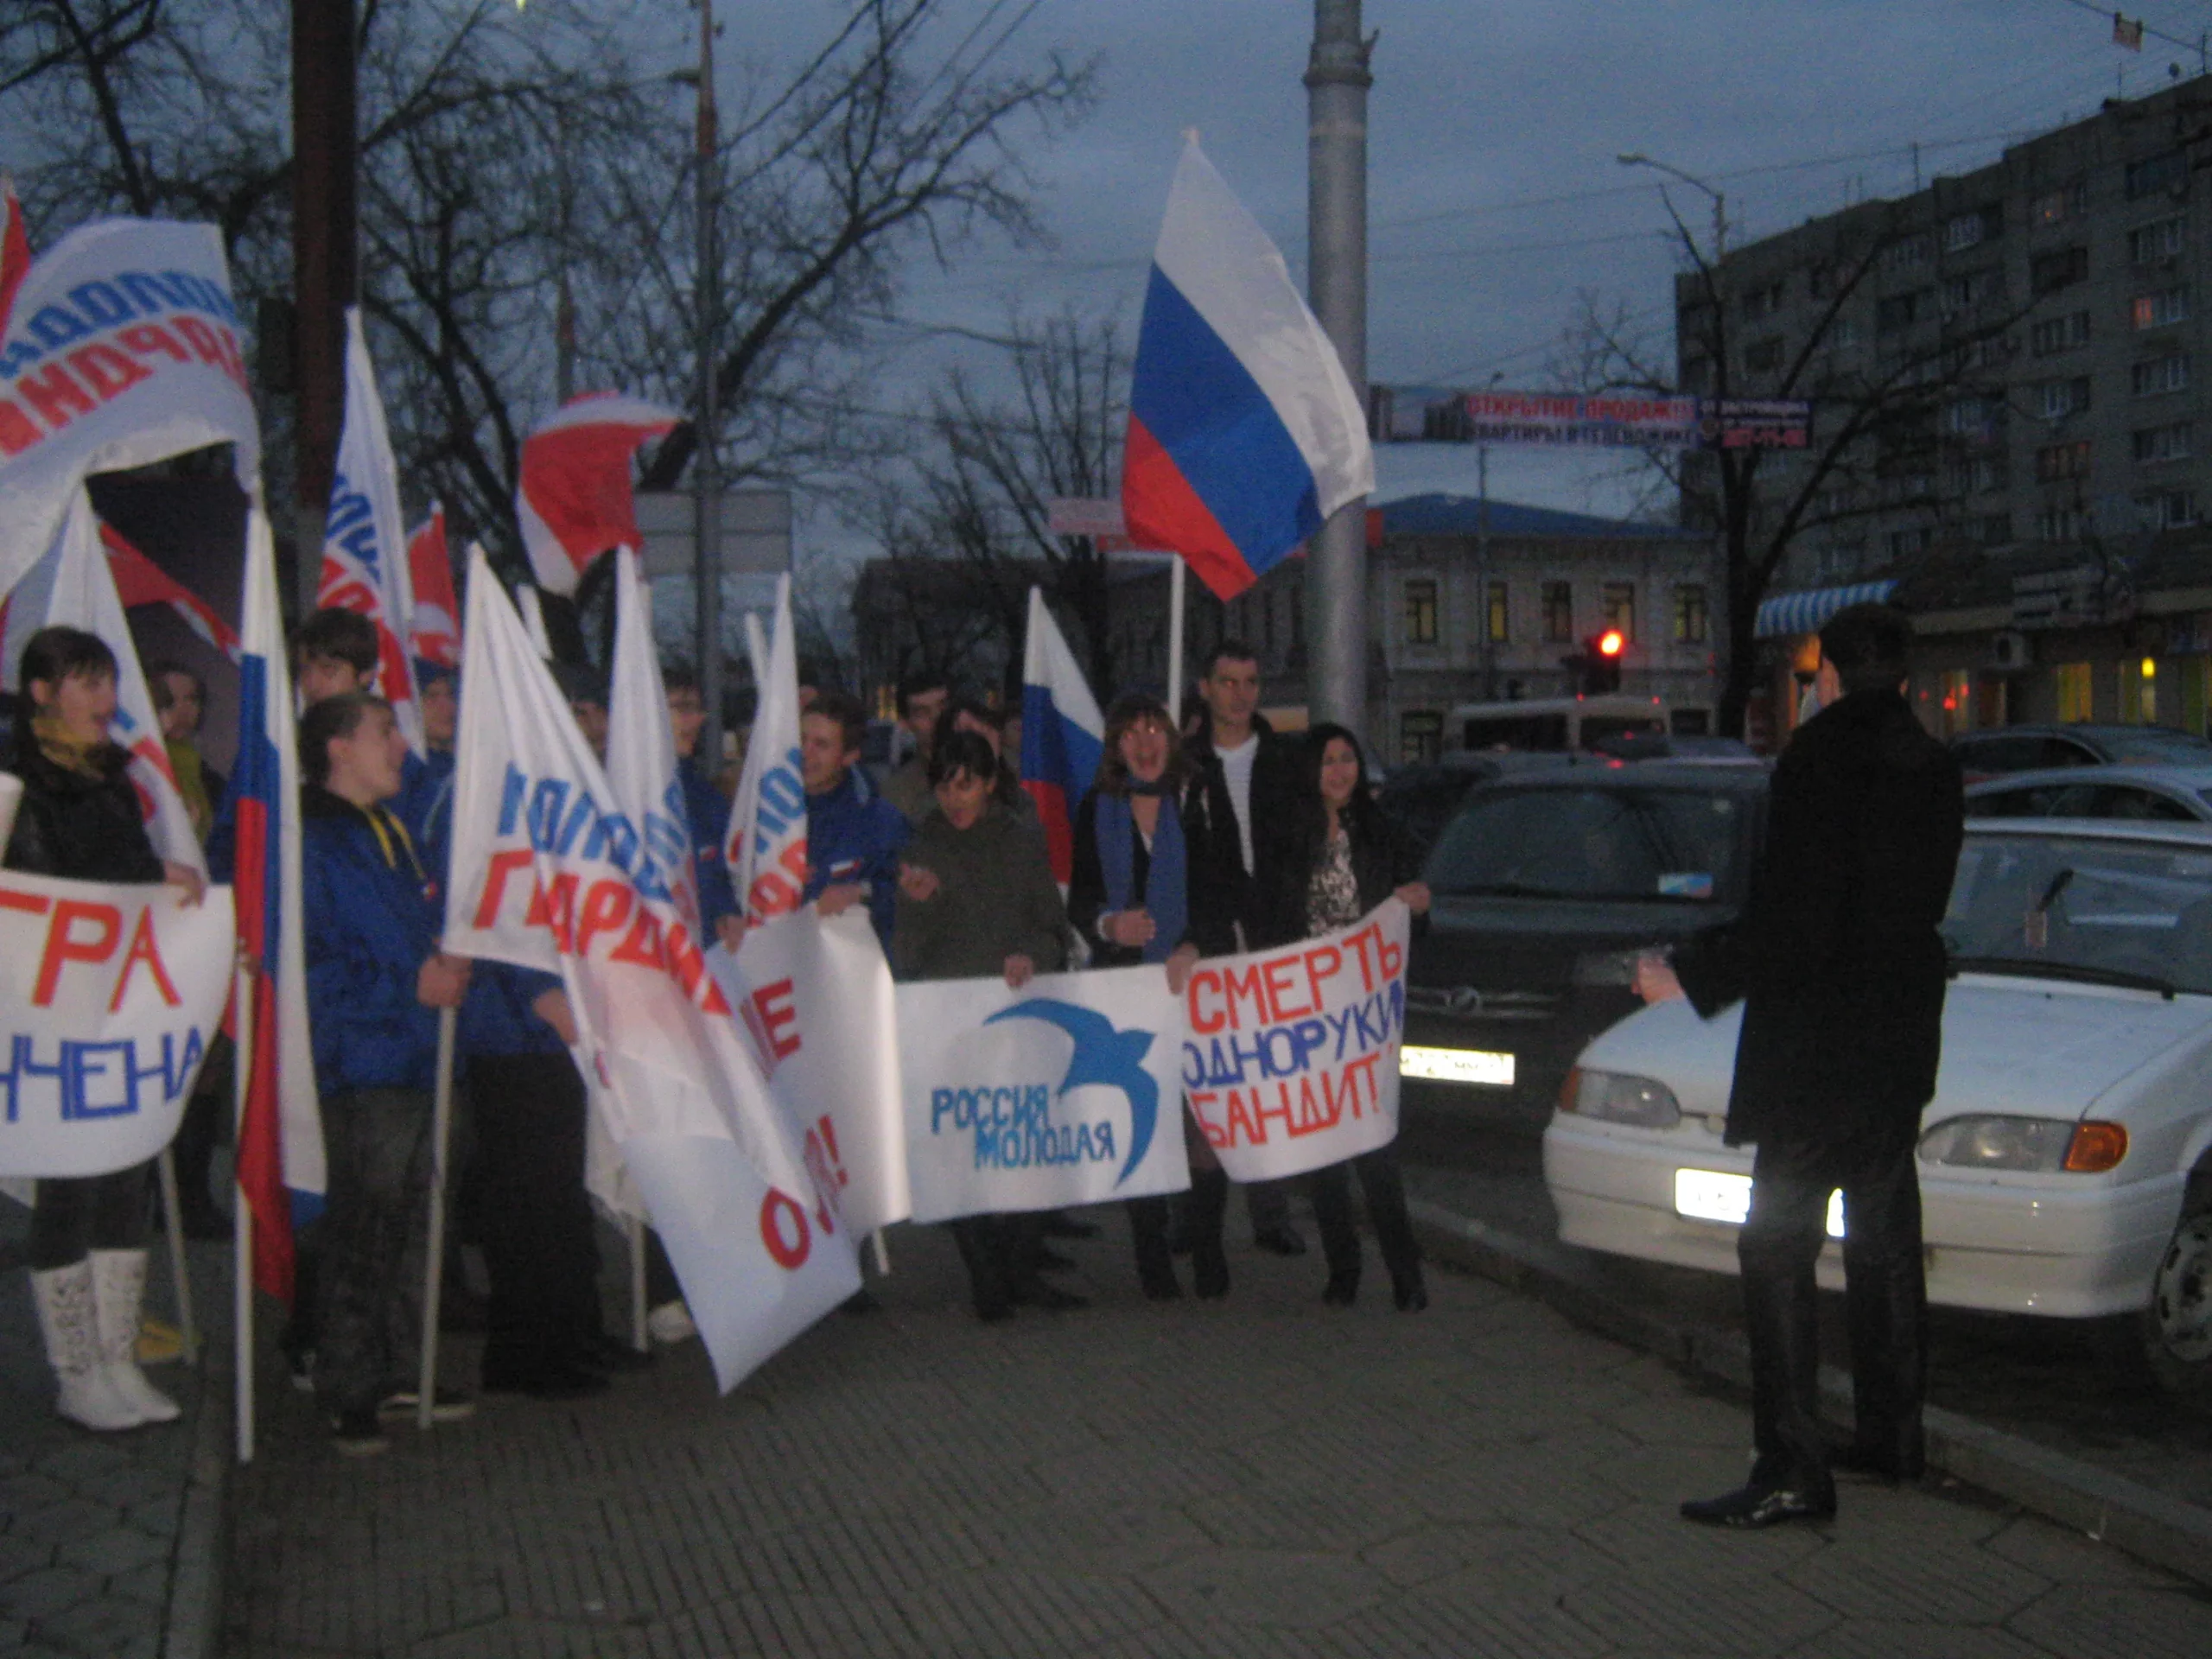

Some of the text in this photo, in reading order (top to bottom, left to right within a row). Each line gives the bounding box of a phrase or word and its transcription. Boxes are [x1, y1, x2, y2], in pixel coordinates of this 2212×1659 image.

[1187, 921, 1402, 1035] СМЕРТЬ
[931, 1083, 1050, 1135] РОССИЯ
[974, 1120, 1116, 1171] МОЛОДАЯ
